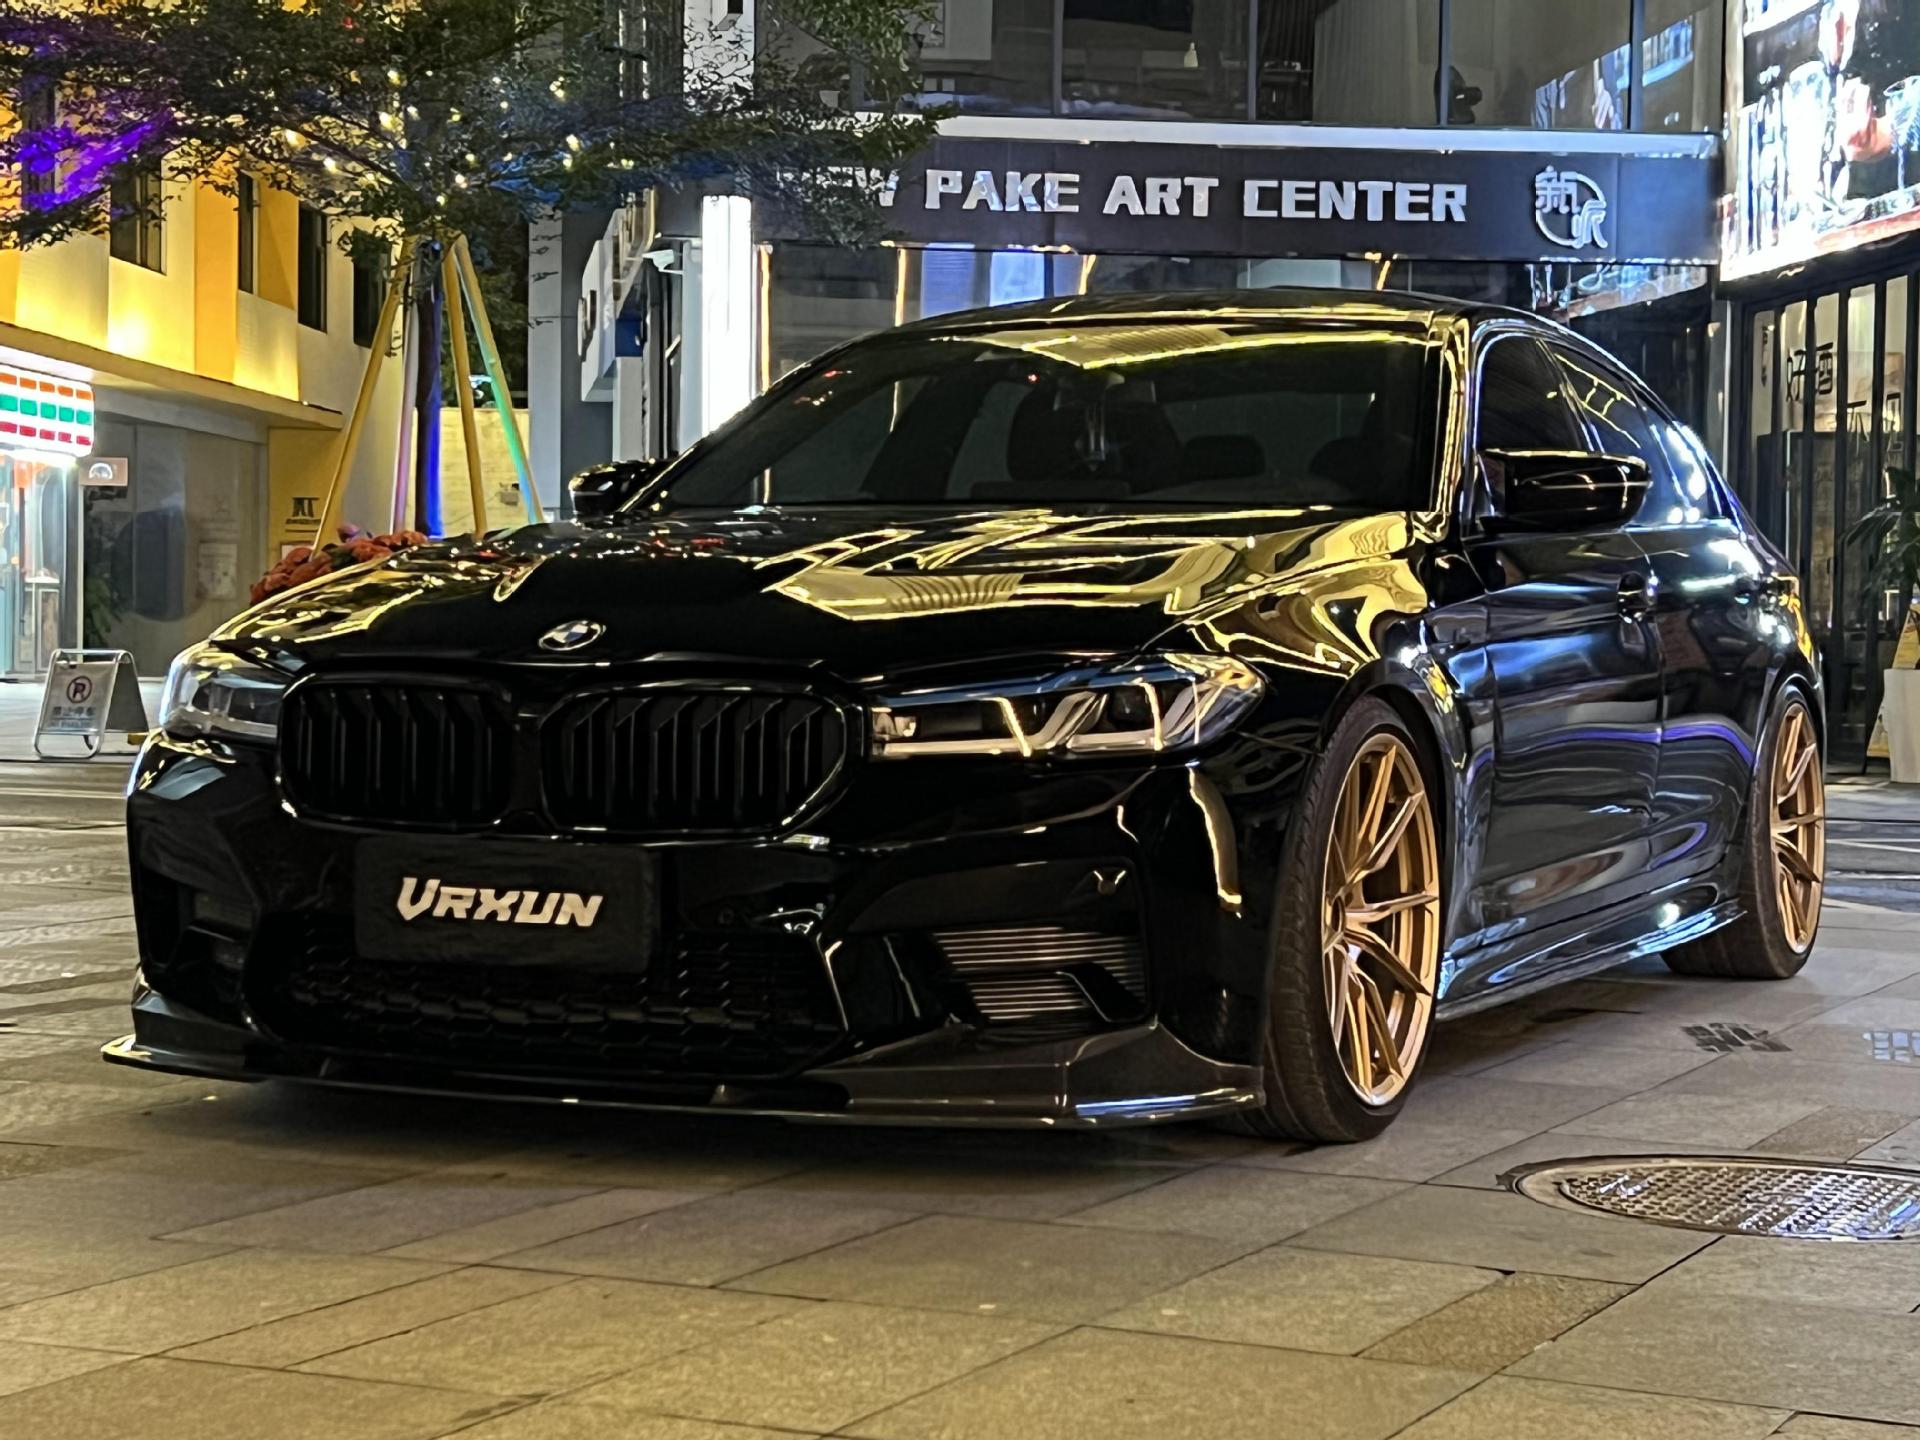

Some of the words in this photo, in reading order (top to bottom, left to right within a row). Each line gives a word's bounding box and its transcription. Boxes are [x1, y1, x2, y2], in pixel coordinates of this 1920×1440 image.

[925, 169, 1080, 212] PAKE
[1102, 176, 1219, 217] ART
[1243, 180, 1467, 222] CENTER
